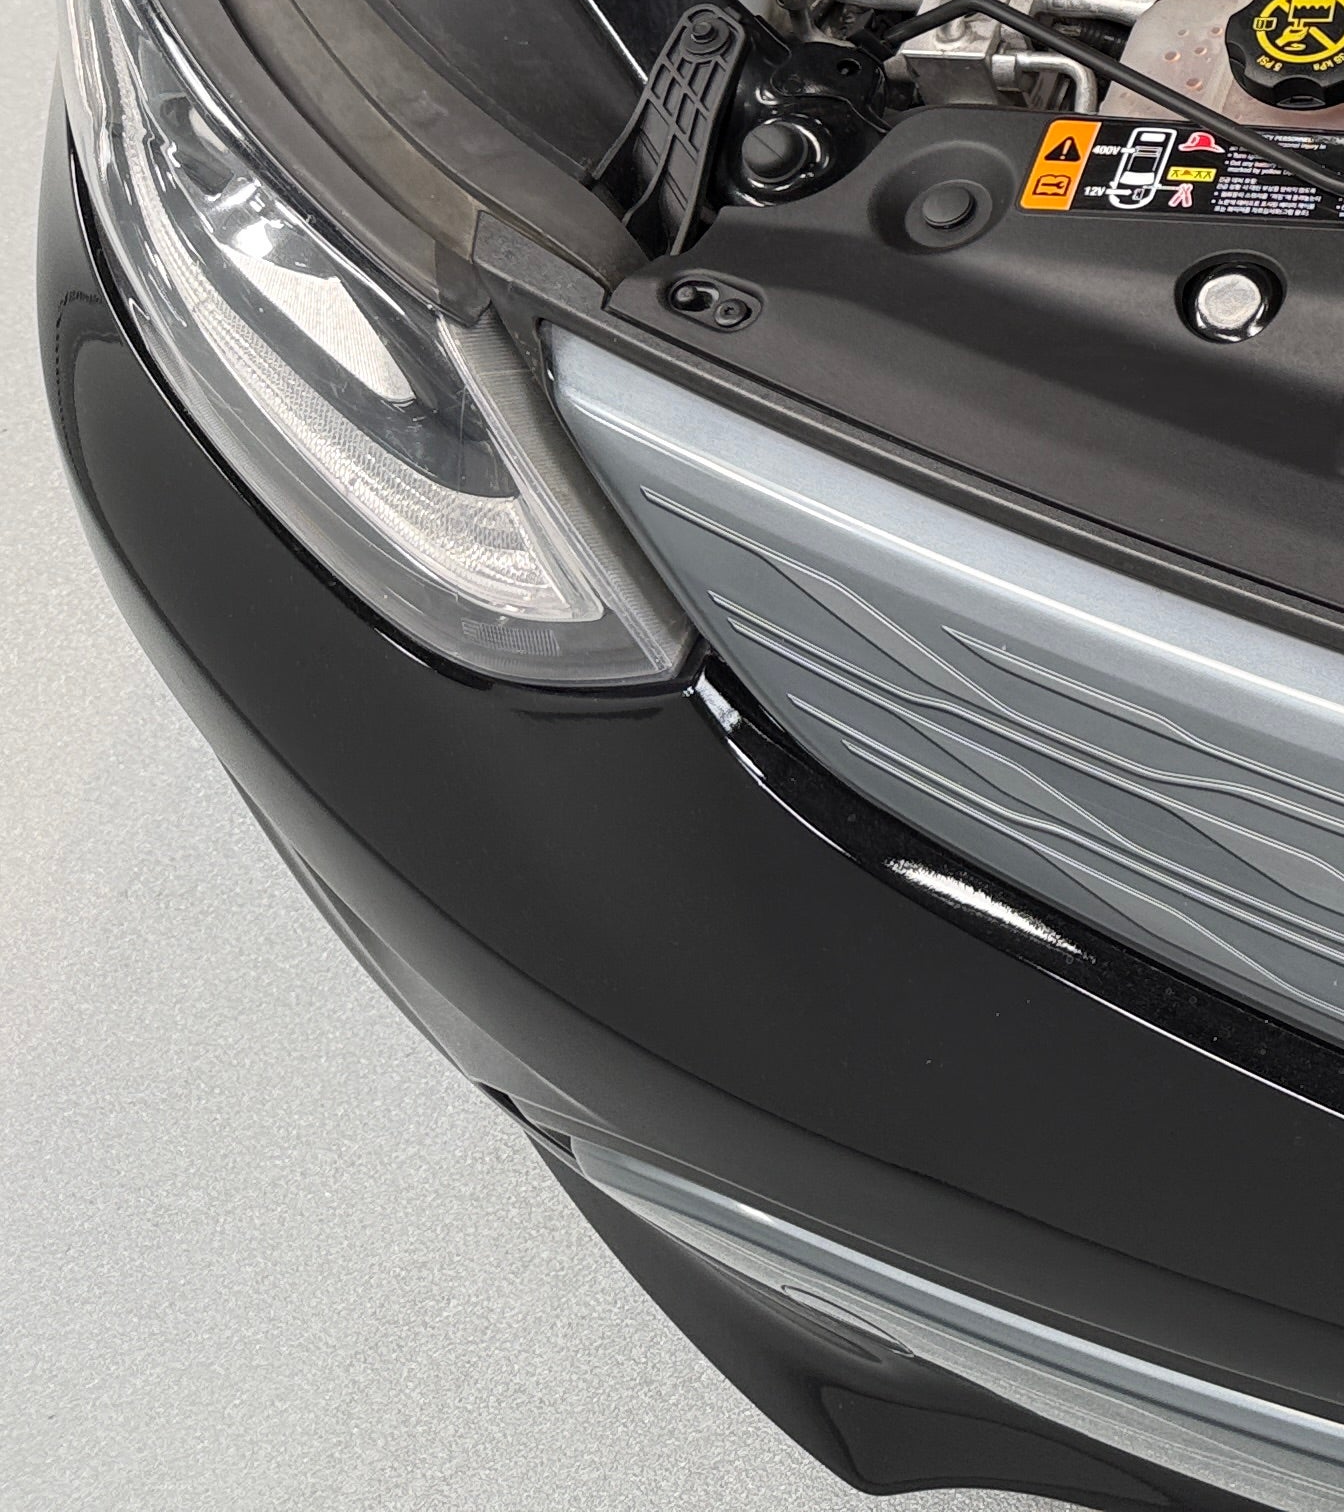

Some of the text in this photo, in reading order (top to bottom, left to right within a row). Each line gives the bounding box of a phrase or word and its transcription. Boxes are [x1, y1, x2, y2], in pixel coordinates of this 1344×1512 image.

[1256, 54, 1283, 72] 5 PSI
[1313, 60, 1334, 72] kPa
[1092, 145, 1121, 156] 400V
[1084, 186, 1106, 197] 12V
